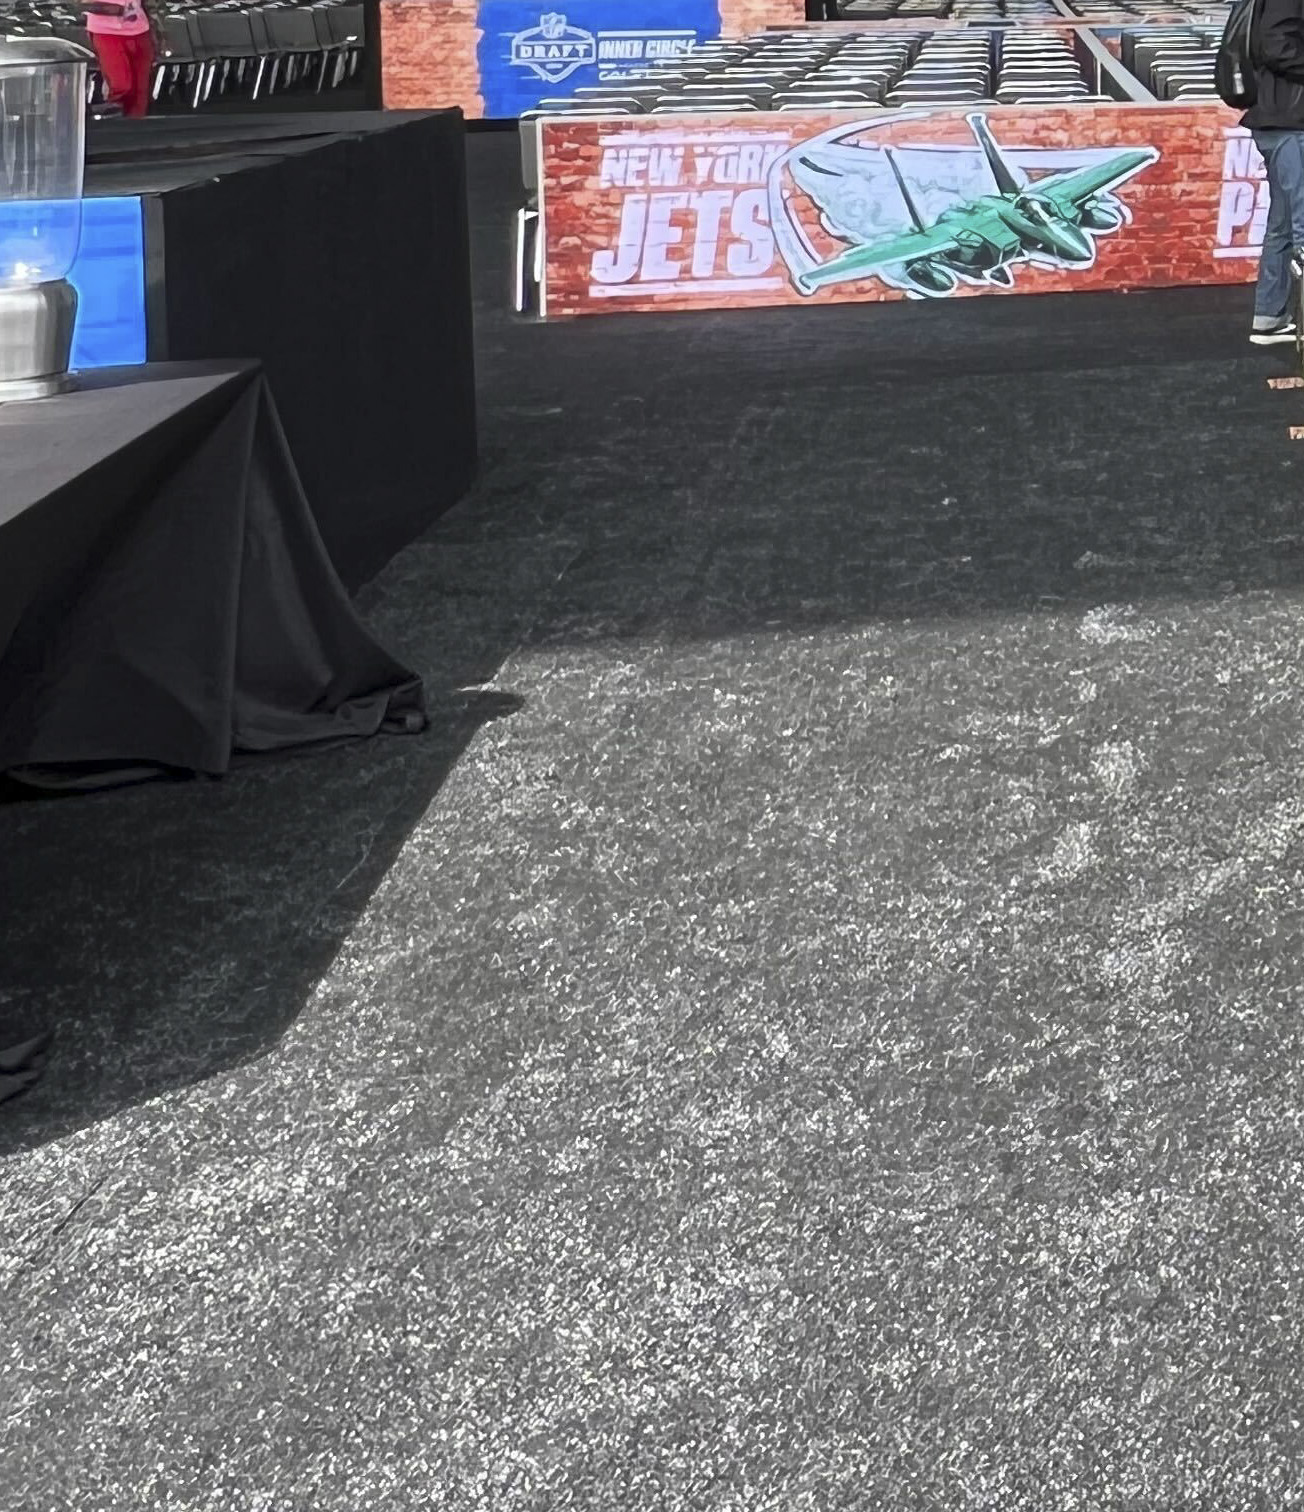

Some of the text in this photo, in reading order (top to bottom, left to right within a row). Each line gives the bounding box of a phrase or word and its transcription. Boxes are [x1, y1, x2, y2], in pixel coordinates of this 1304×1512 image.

[519, 44, 590, 59] DRAFT
[598, 40, 644, 59] INNER
[600, 140, 792, 189] NEW YORK
[589, 189, 775, 285] JETS
